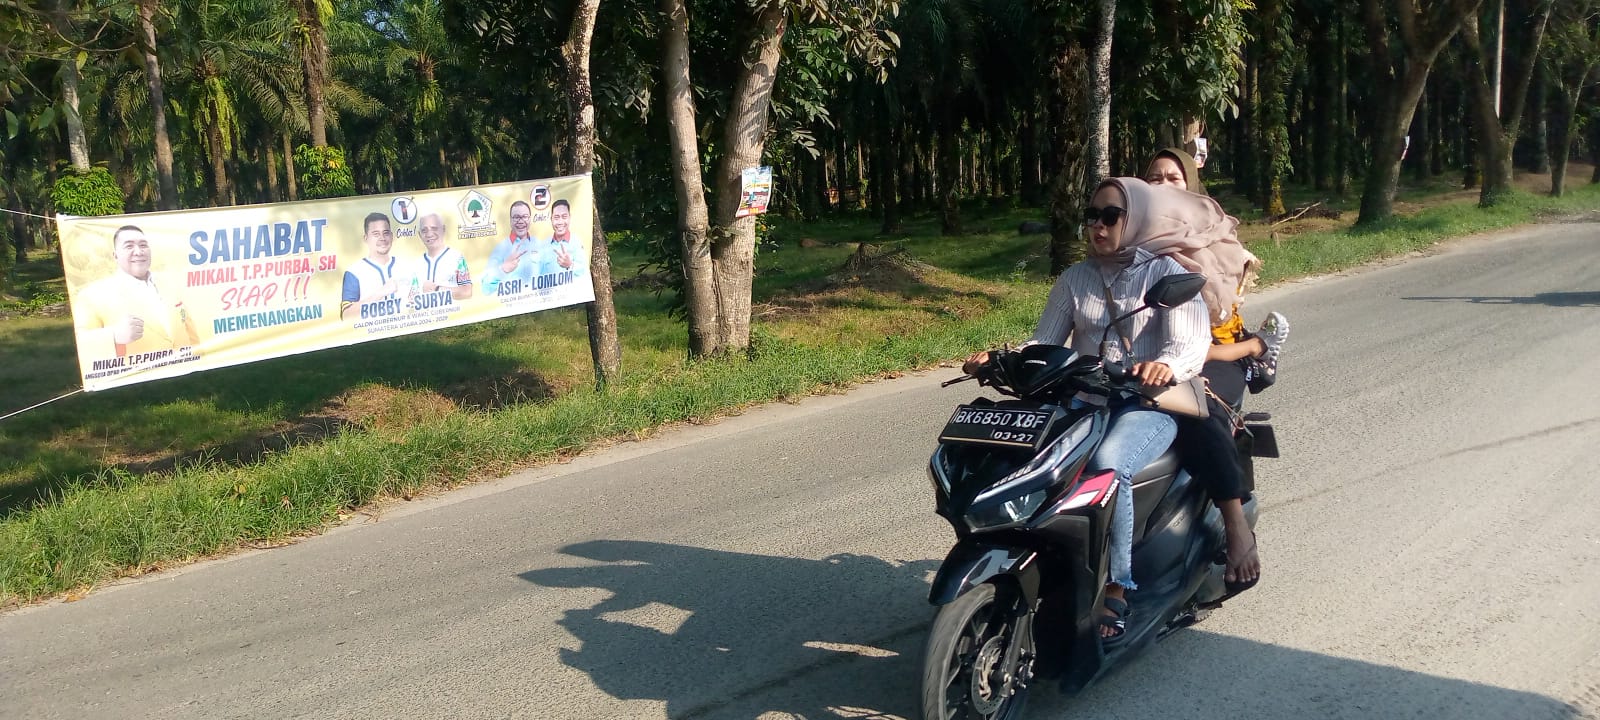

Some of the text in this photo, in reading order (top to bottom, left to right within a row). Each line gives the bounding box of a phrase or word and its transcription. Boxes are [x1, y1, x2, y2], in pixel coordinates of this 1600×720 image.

[399, 201, 408, 220] 1
[188, 219, 327, 266] SAHABAT
[187, 267, 238, 287] MIKAIL
[319, 255, 337, 271] SH
[497, 279, 522, 297] ASRI
[532, 271, 573, 290] LOMLOM
[221, 282, 278, 311] SIAP
[360, 298, 402, 319] BOBBY
[414, 290, 453, 311] SURYA
[213, 304, 323, 335] MEMENANGKAN
[93, 355, 126, 371] MIKAIL
